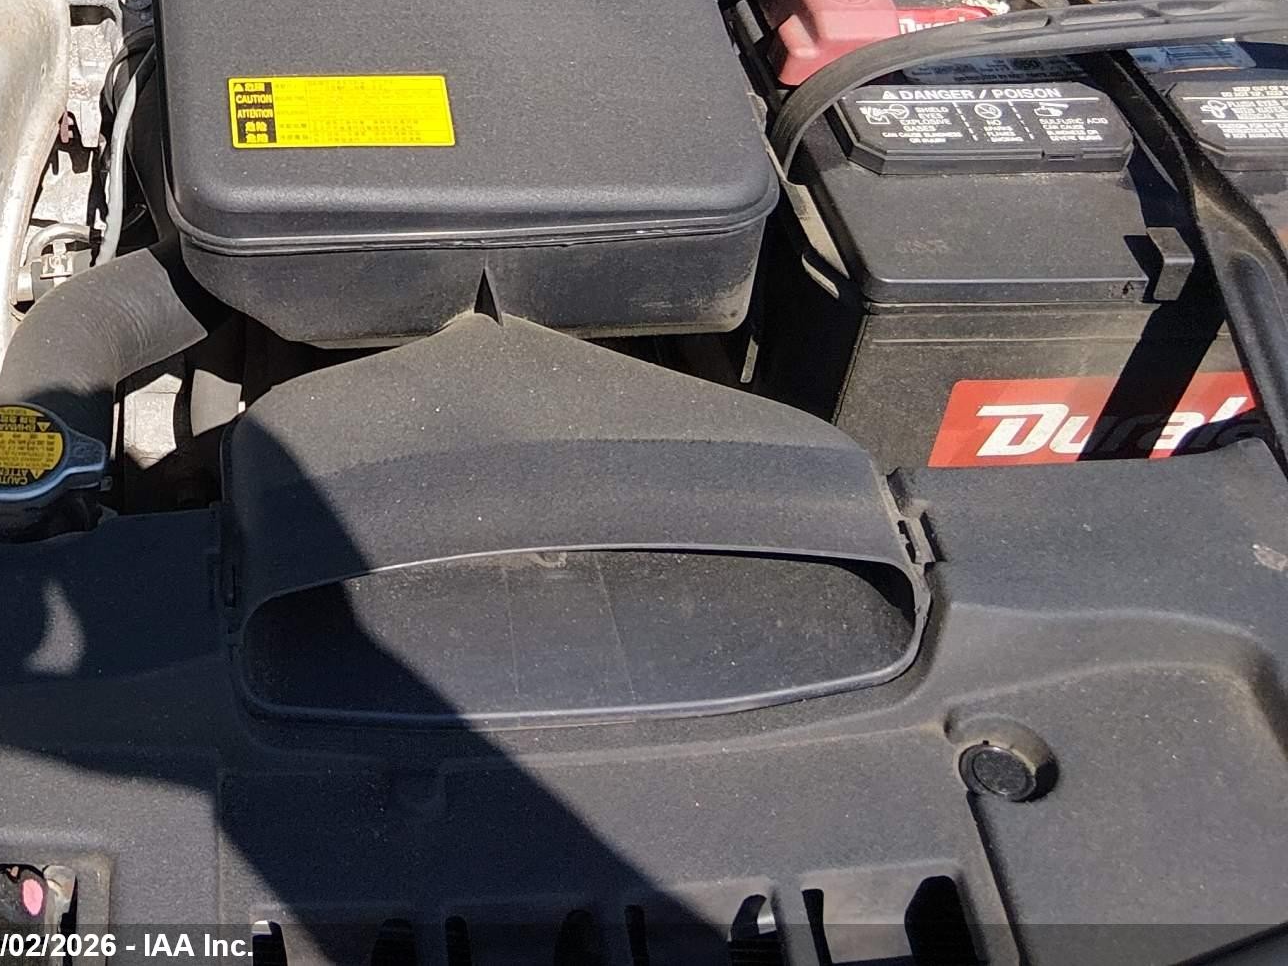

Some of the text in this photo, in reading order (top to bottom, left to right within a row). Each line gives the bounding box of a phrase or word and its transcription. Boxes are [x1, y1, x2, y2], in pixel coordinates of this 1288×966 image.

[235, 94, 273, 104] CAUTION
[898, 88, 1062, 100] DANGER / POISON
[237, 108, 274, 119] ATTENTION
